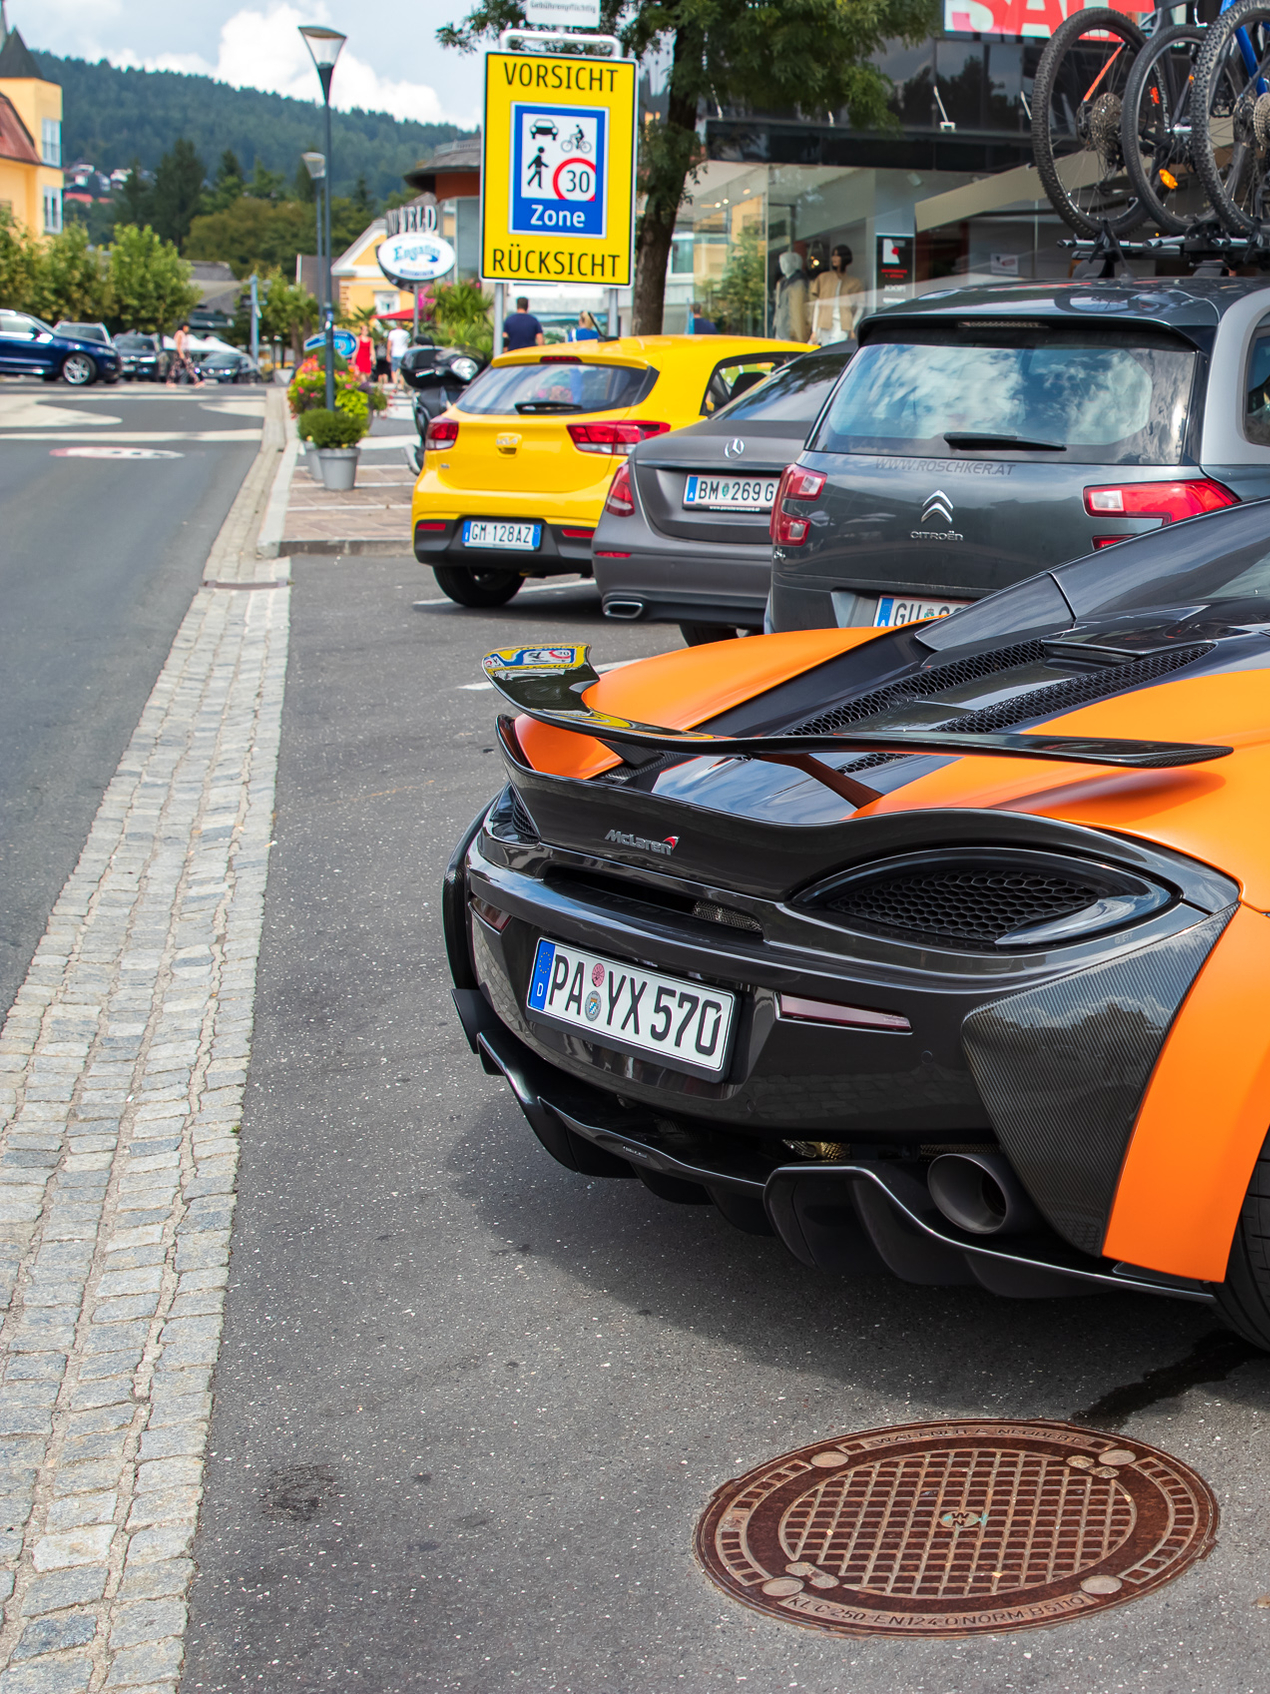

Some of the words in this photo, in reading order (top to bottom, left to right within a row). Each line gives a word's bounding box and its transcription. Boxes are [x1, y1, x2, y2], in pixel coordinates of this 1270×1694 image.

[503, 62, 619, 92] VORSICHT
[565, 169, 590, 193] 30
[530, 204, 586, 228] Zone
[492, 243, 621, 277] RÜCKSICHT
[875, 457, 1016, 476] WWW.ROSCHKER.AT
[698, 480, 720, 500] BM
[731, 481, 761, 501] 269
[471, 523, 487, 541] GM
[493, 524, 532, 544] 128AZ
[604, 829, 672, 856] McLaren
[549, 953, 586, 1017] PA
[606, 970, 648, 1035] YX
[650, 985, 723, 1057] 570
[831, 1608, 867, 1622] 250
